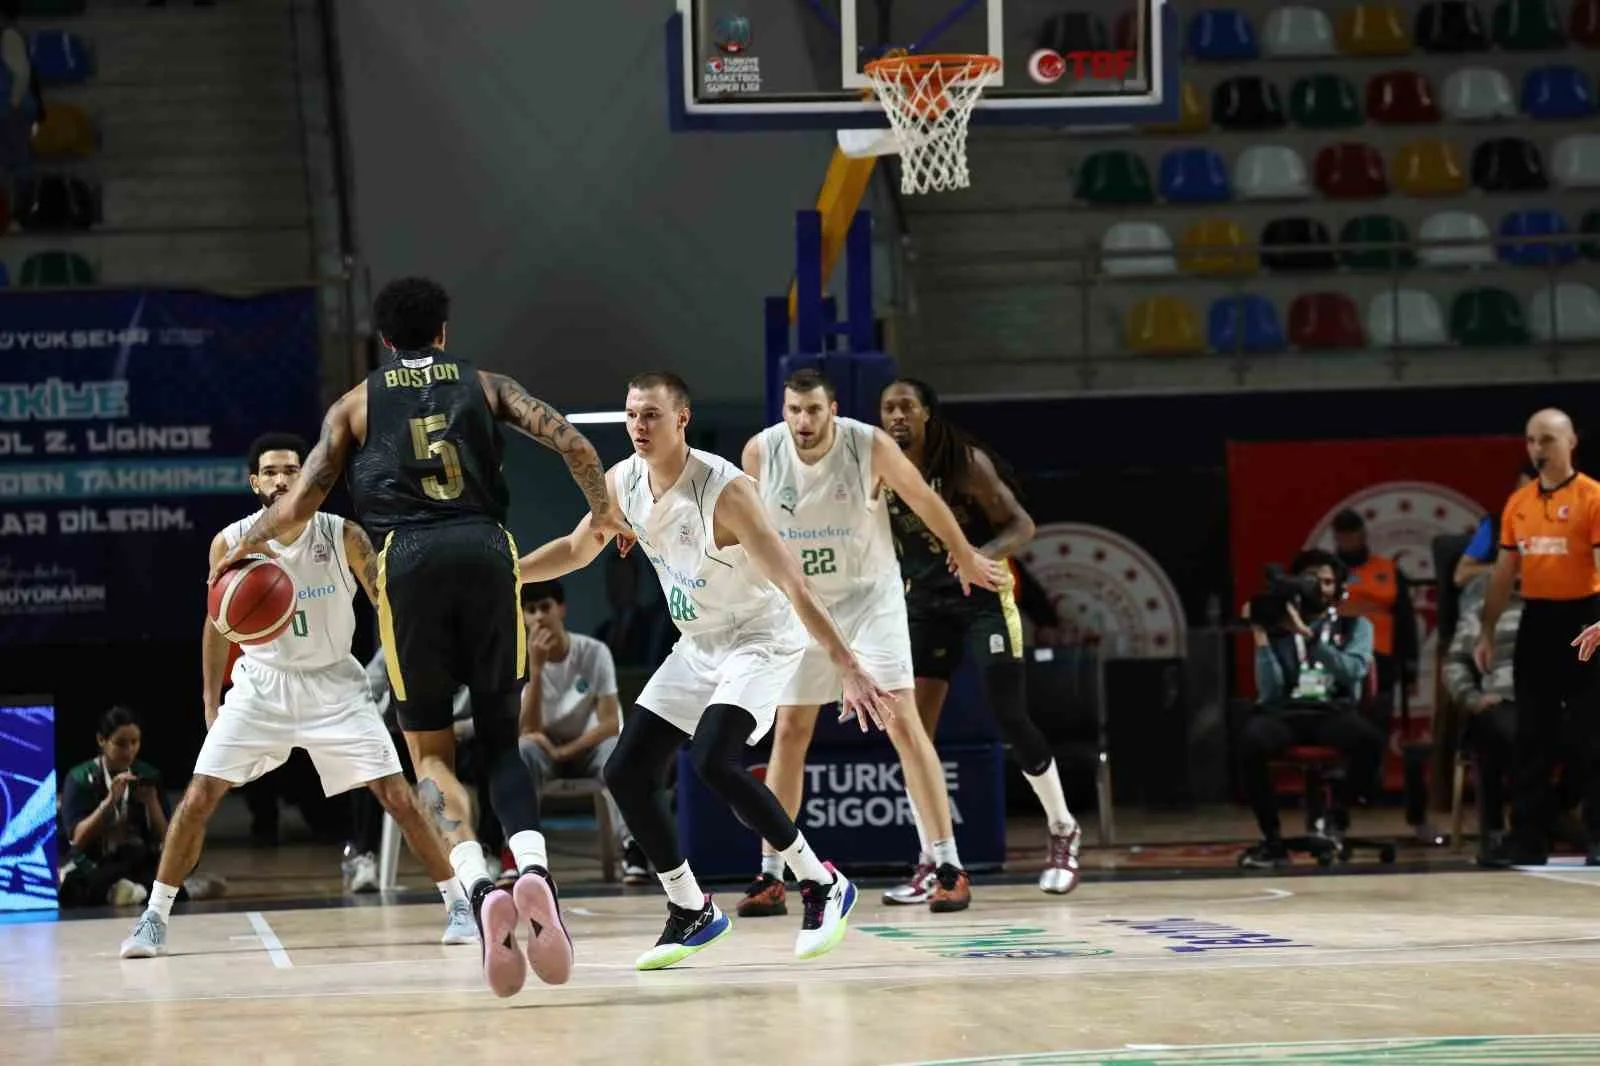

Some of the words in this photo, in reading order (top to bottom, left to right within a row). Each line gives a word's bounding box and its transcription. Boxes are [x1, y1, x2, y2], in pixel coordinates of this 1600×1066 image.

[385, 363, 460, 388] BOSTON
[410, 413, 465, 500] 5
[58, 504, 195, 533] DİLERİM.
[802, 547, 837, 576] 22
[805, 763, 959, 793] TÜRKE
[805, 797, 963, 827] SİGORA
